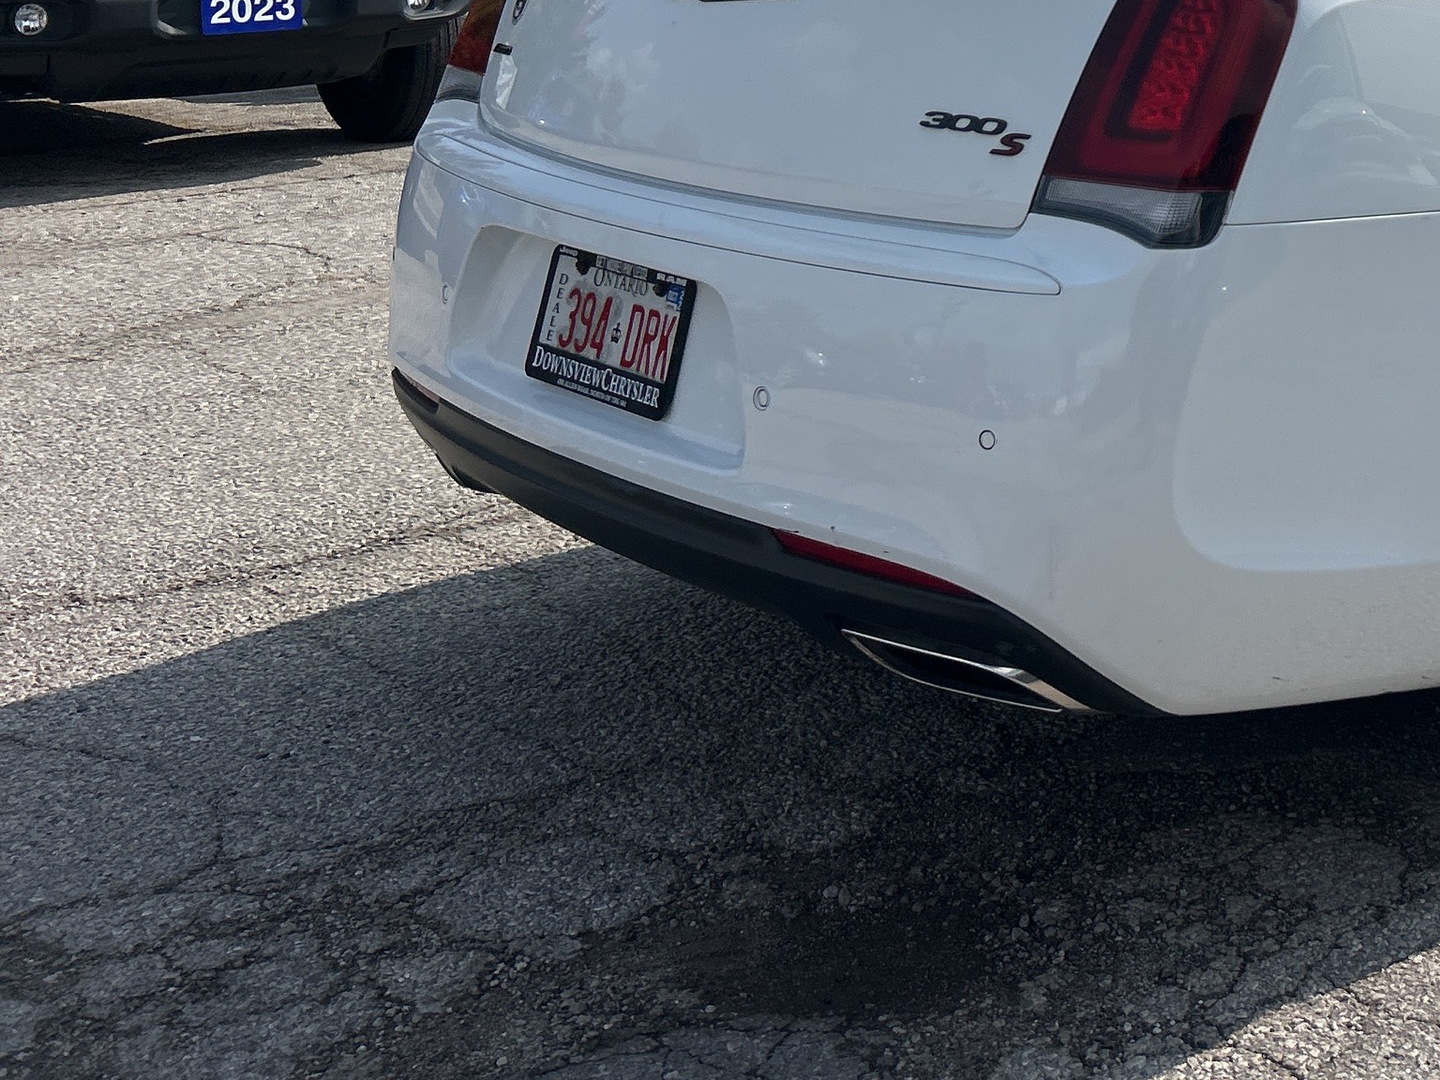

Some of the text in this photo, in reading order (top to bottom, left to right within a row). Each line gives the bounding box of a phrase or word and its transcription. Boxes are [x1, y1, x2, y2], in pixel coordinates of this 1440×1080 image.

[919, 111, 1008, 135] 300
[593, 268, 649, 297] ONTARIO
[546, 273, 569, 342] DEALE
[558, 287, 677, 381] 394 DRK
